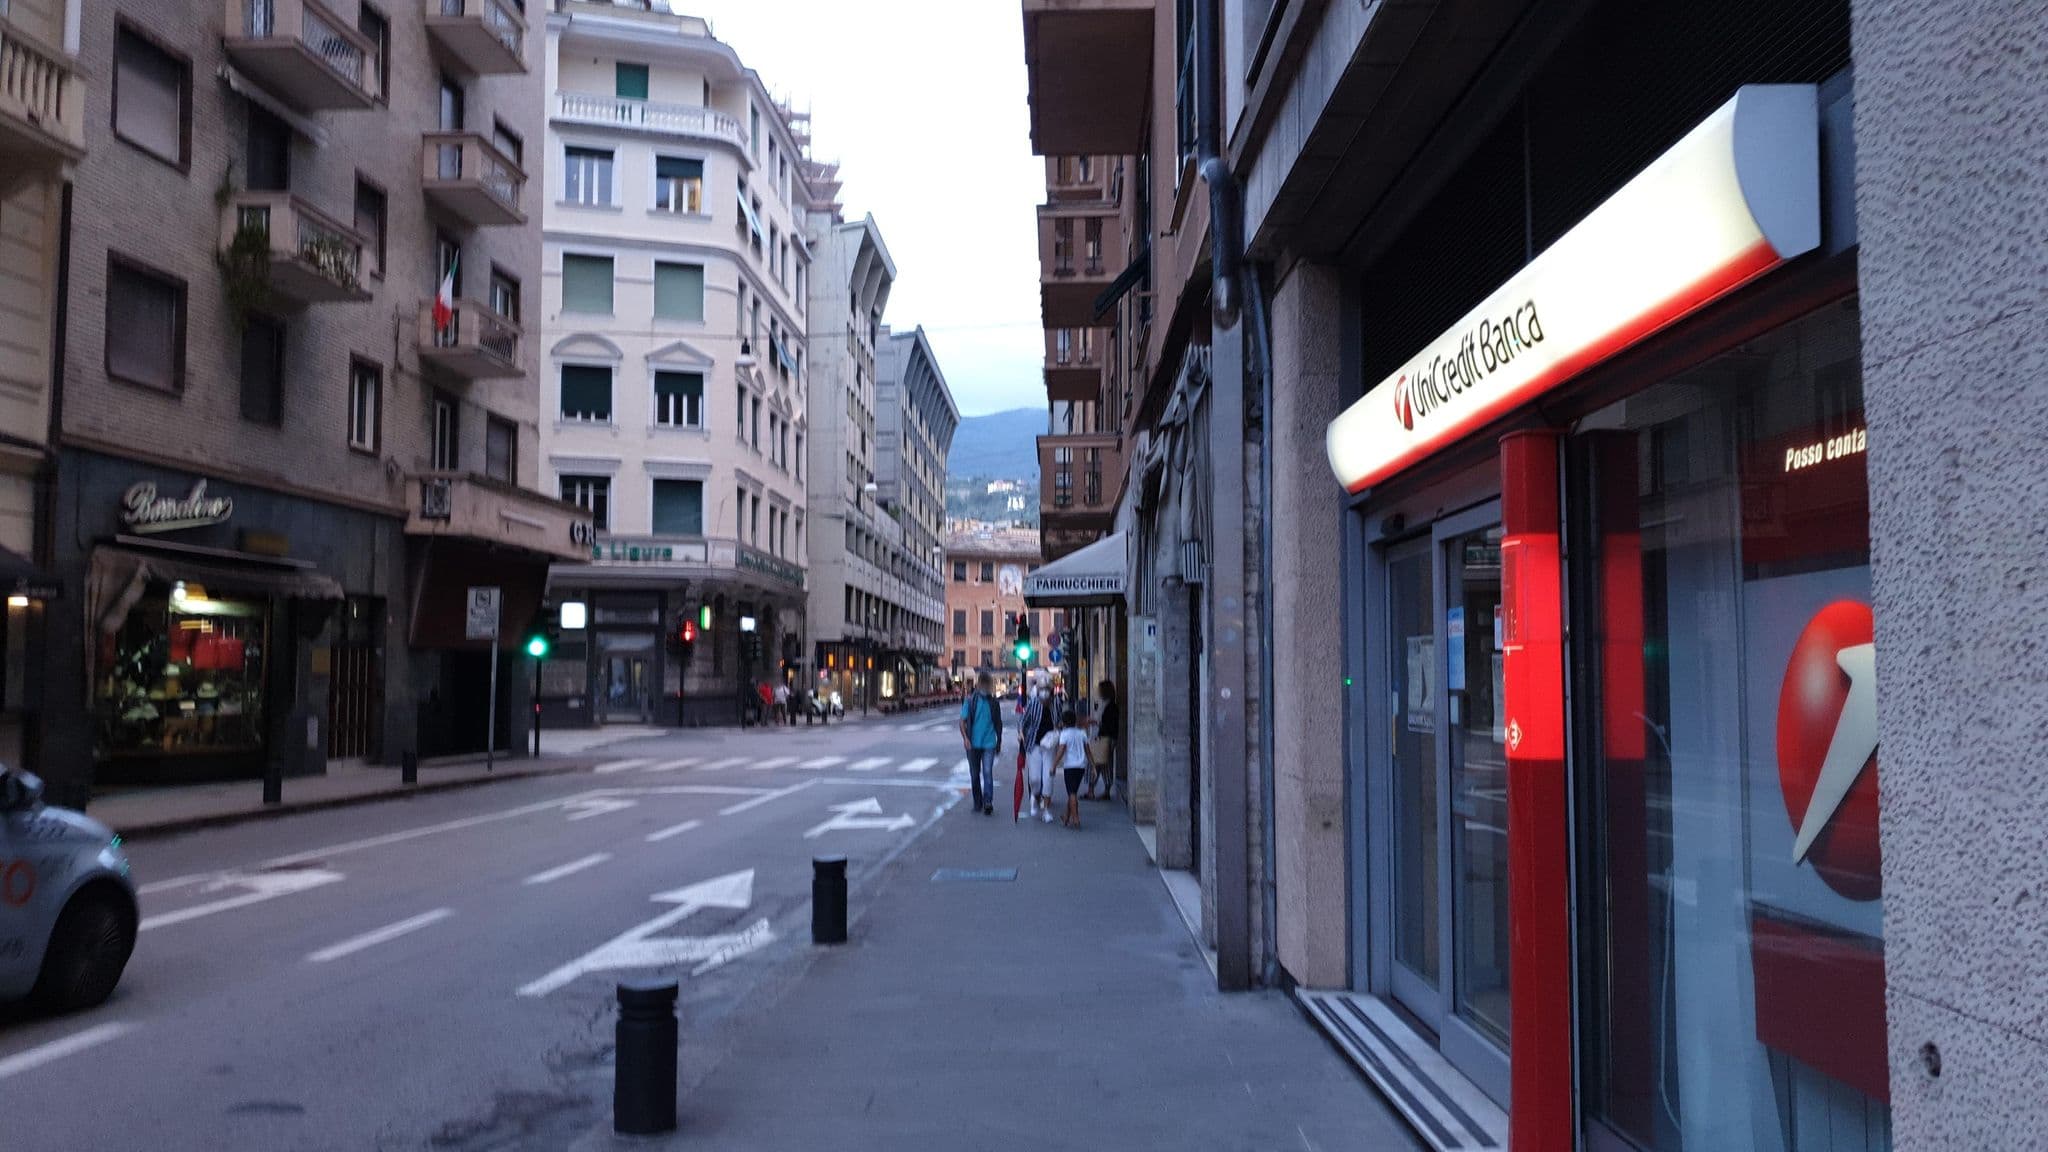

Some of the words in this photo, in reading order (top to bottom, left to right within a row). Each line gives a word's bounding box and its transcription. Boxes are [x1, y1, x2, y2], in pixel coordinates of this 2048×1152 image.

[1411, 329, 1483, 417] UniCredit
[1479, 298, 1545, 375] Banca
[1785, 442, 1823, 473] Posso
[1036, 578, 1119, 591] PARRUCCHIERE
